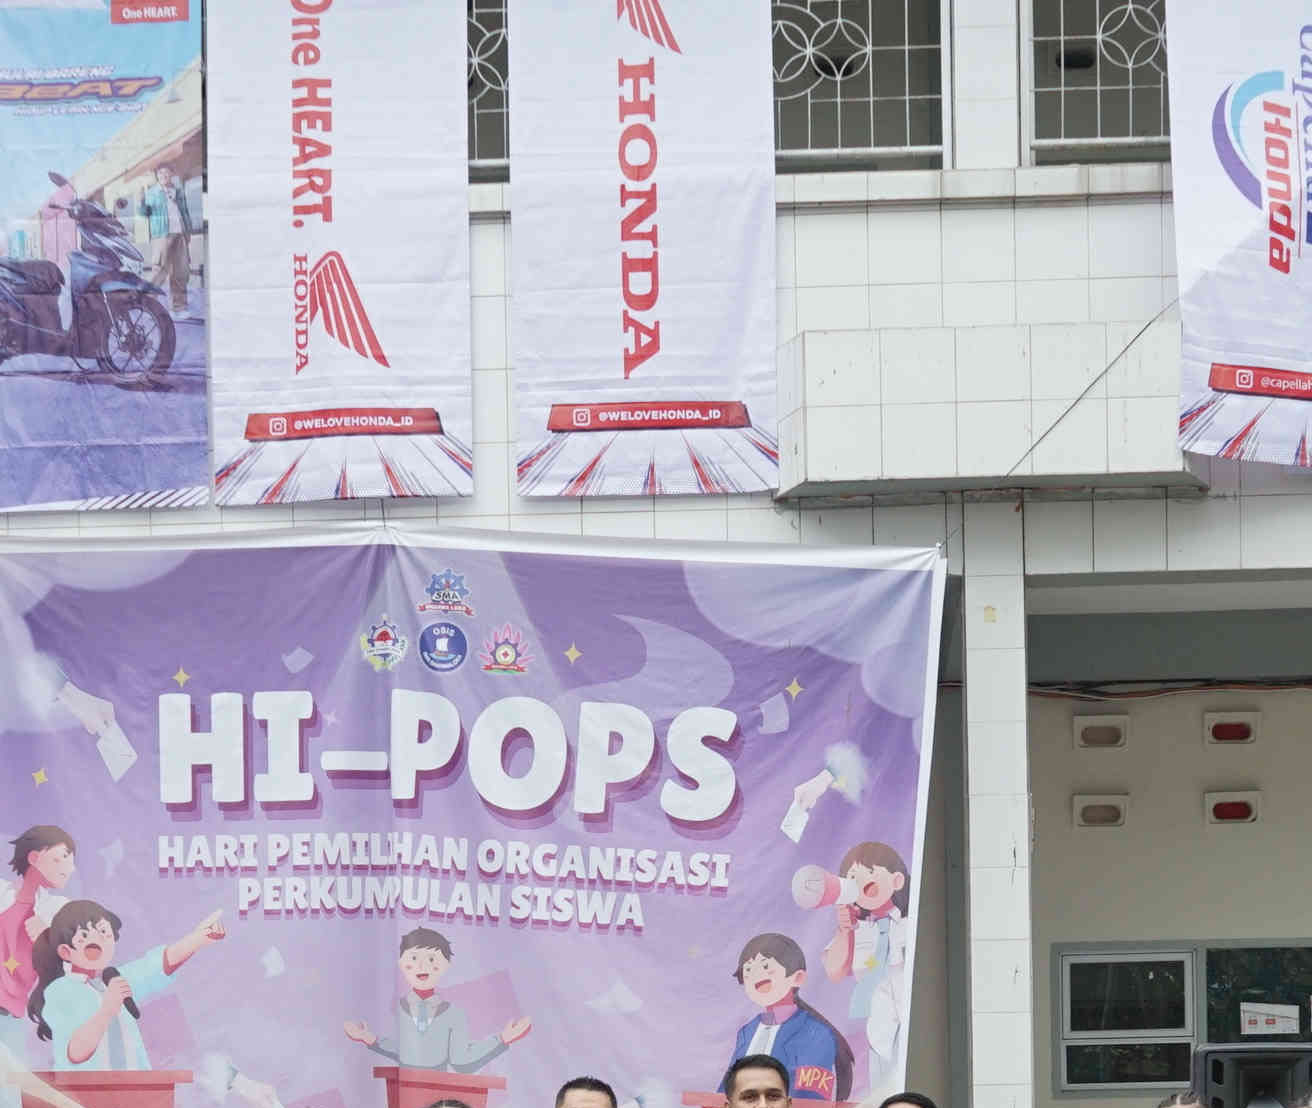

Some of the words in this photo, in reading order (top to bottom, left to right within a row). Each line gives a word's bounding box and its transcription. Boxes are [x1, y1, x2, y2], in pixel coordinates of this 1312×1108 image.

[290, 78, 333, 228] HEART.
[1262, 100, 1296, 275] Honda
[616, 58, 663, 380] HONDA
[295, 253, 309, 375] HONDA
[292, 412, 415, 431] @WELOVEHONDA_ID
[597, 407, 723, 424] @WELOVEHONDA_ID
[158, 834, 259, 872] HARI
[477, 839, 733, 890] ORGANISASI
[510, 884, 646, 930] SISWA
[798, 1067, 833, 1091] MPK
